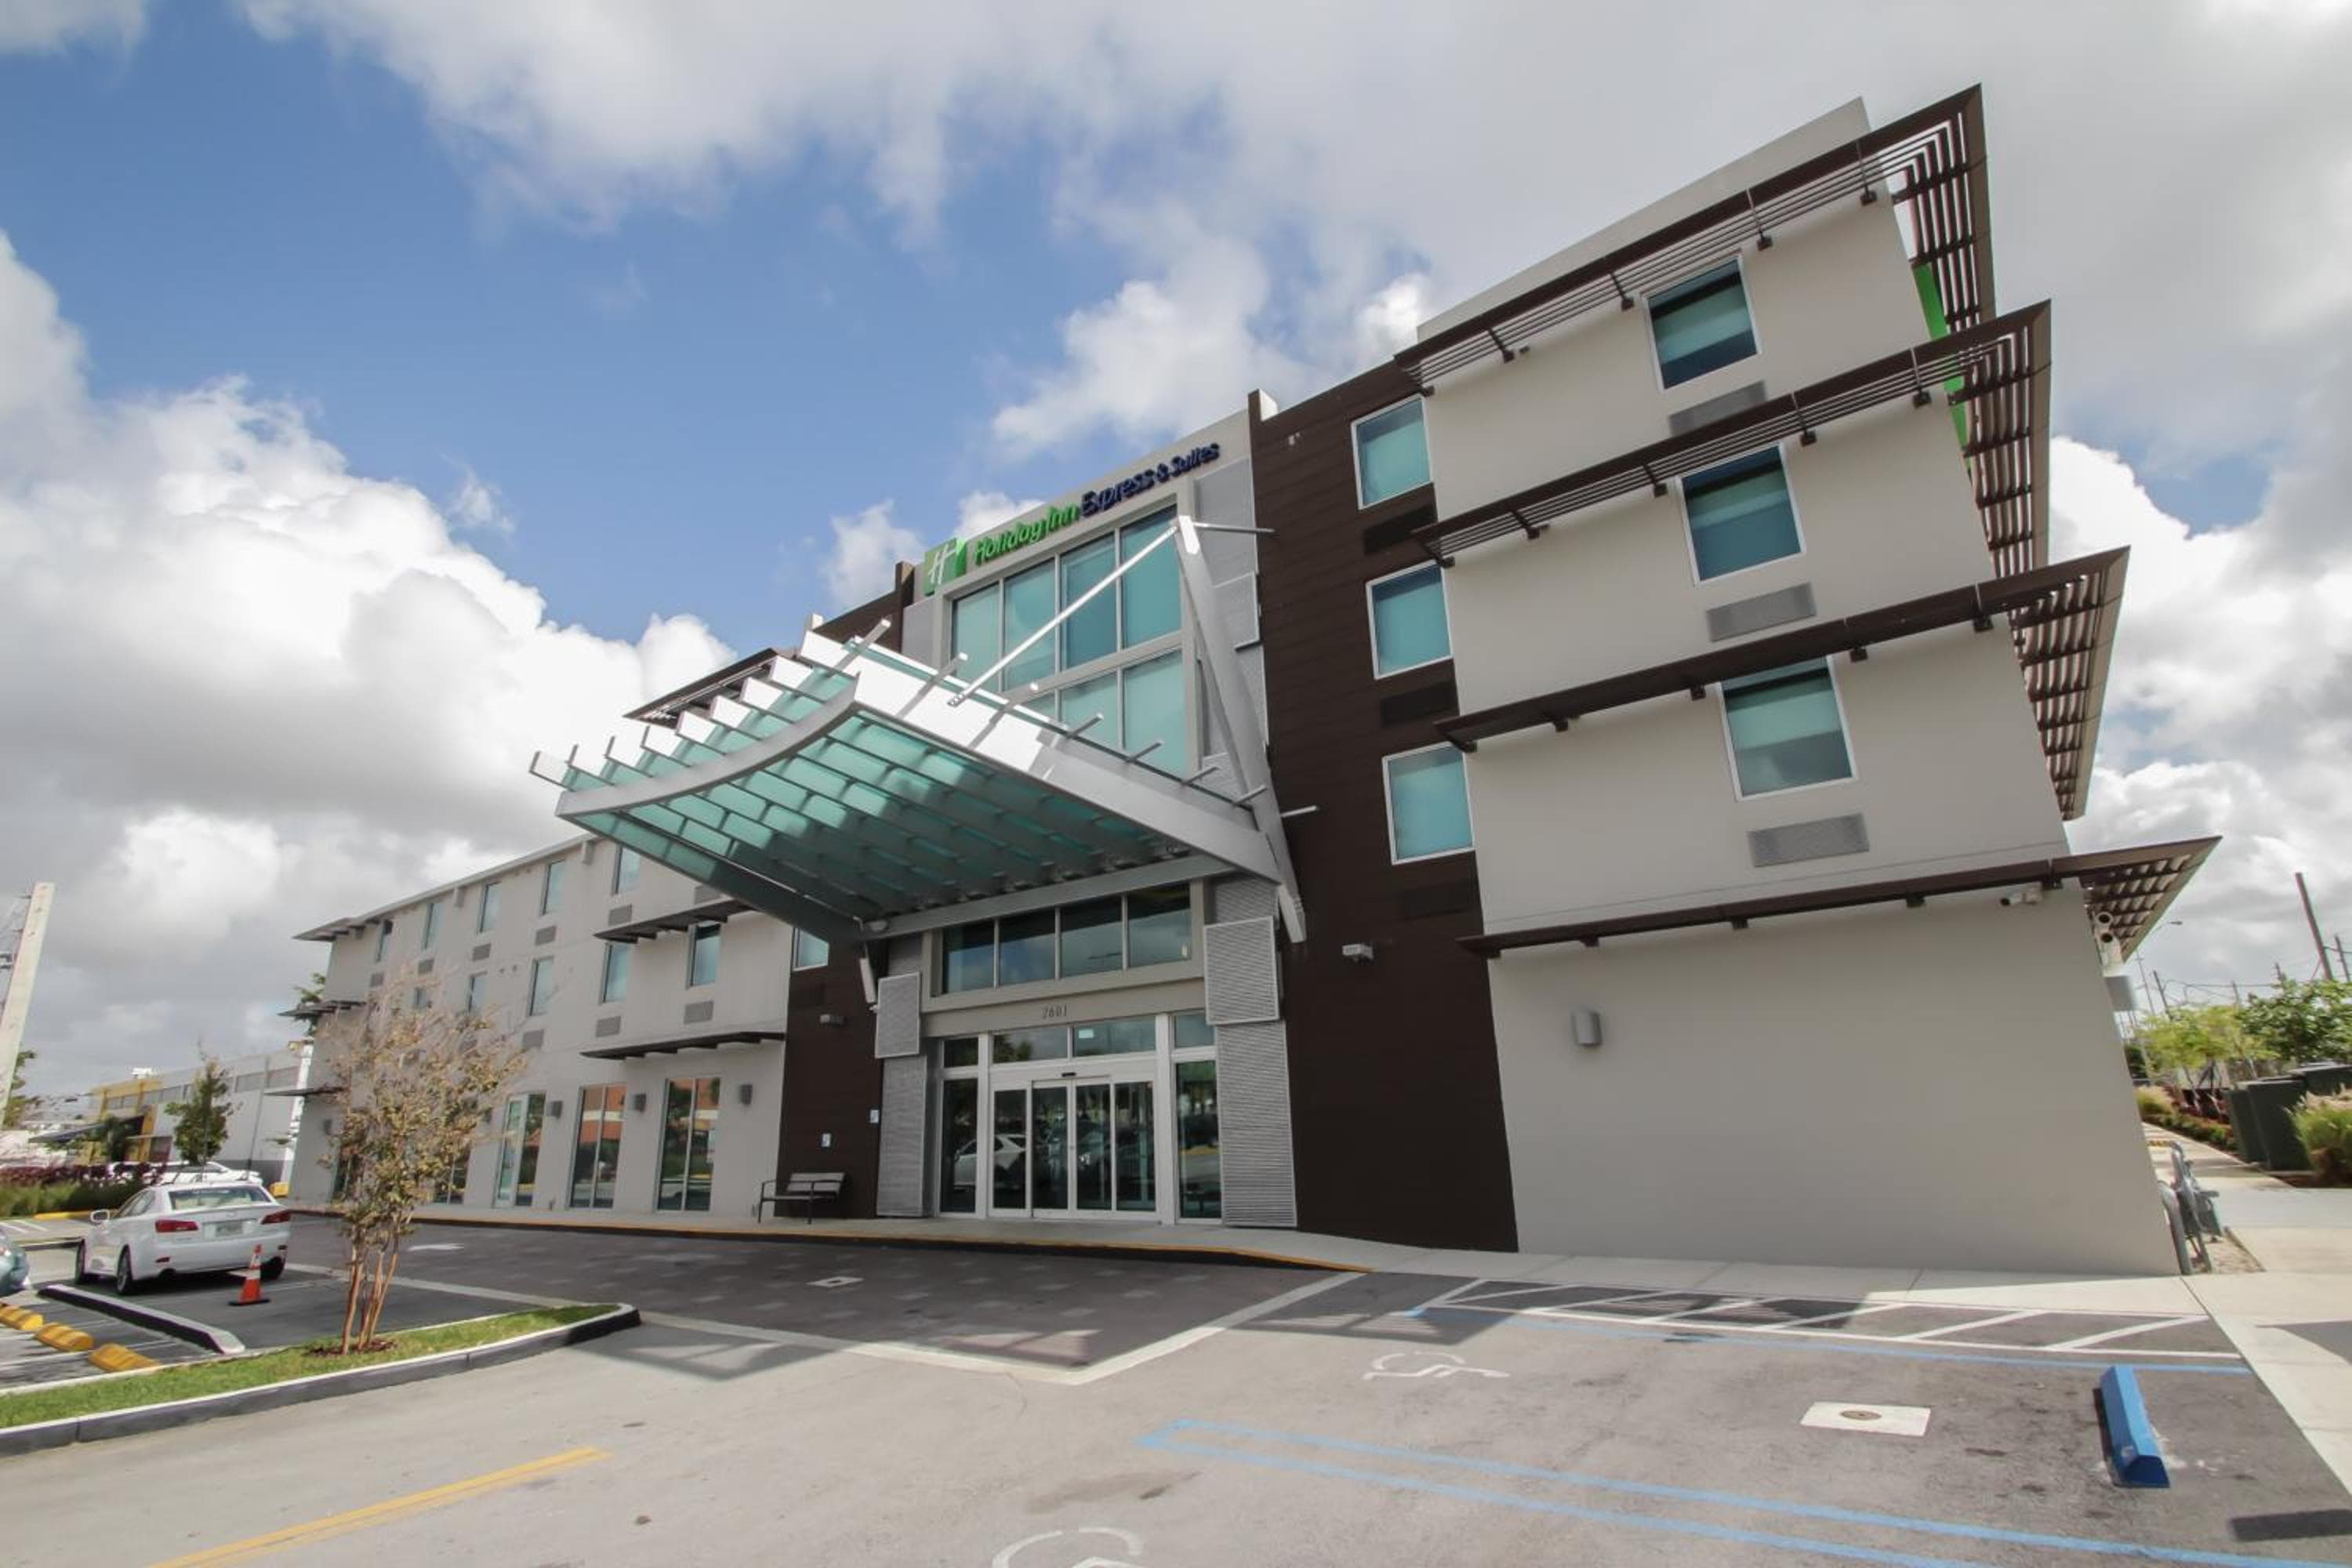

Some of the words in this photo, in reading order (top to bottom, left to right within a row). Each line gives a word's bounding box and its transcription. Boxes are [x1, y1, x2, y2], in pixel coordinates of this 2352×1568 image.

[975, 521, 1047, 566] Holiday
[1046, 504, 1080, 532] Inn
[1080, 469, 1155, 517] Express
[1156, 463, 1170, 483] &
[1171, 443, 1220, 477] Suites
